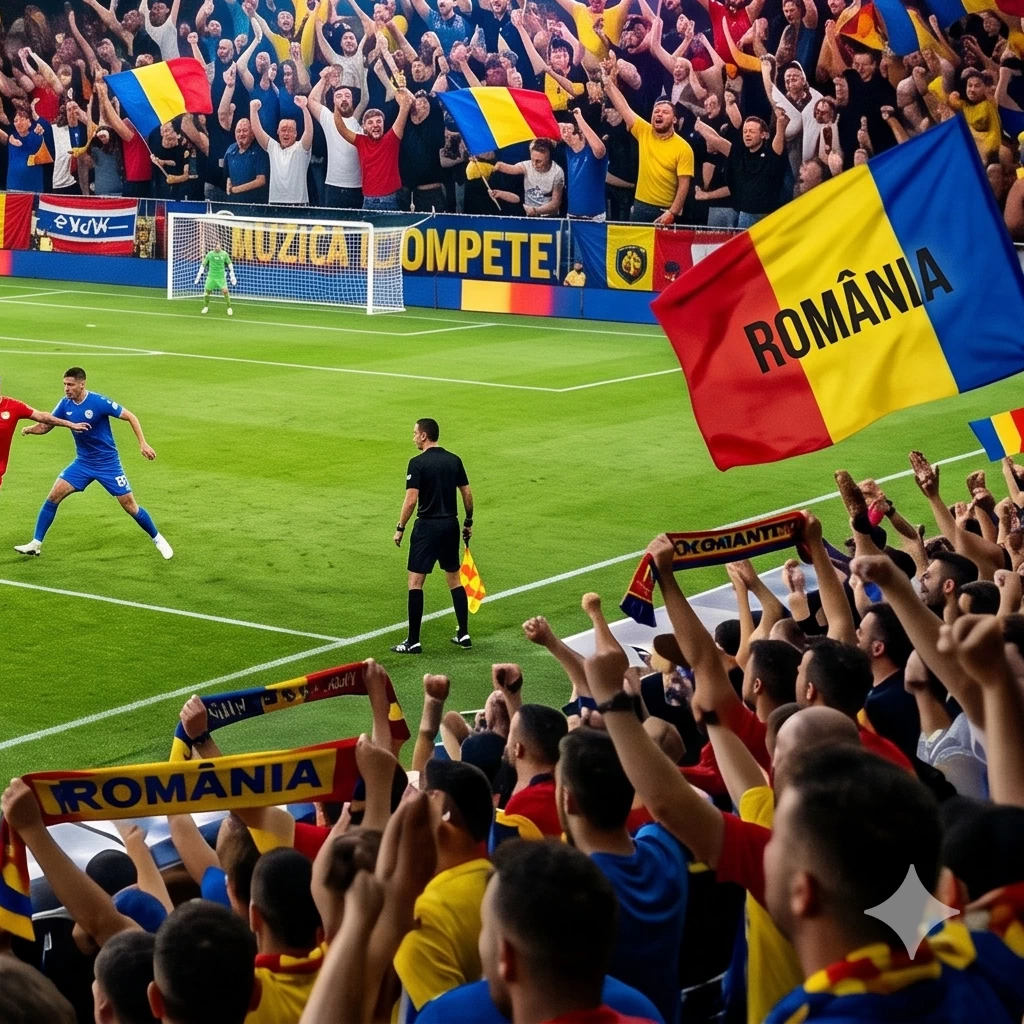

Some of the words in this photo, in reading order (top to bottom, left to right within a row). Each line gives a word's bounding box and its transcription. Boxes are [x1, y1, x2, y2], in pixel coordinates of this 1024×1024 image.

[231, 223, 349, 267] MUZICA
[743, 247, 954, 374] ROMÂNIA
[50, 758, 323, 815] ROMÂNIA
